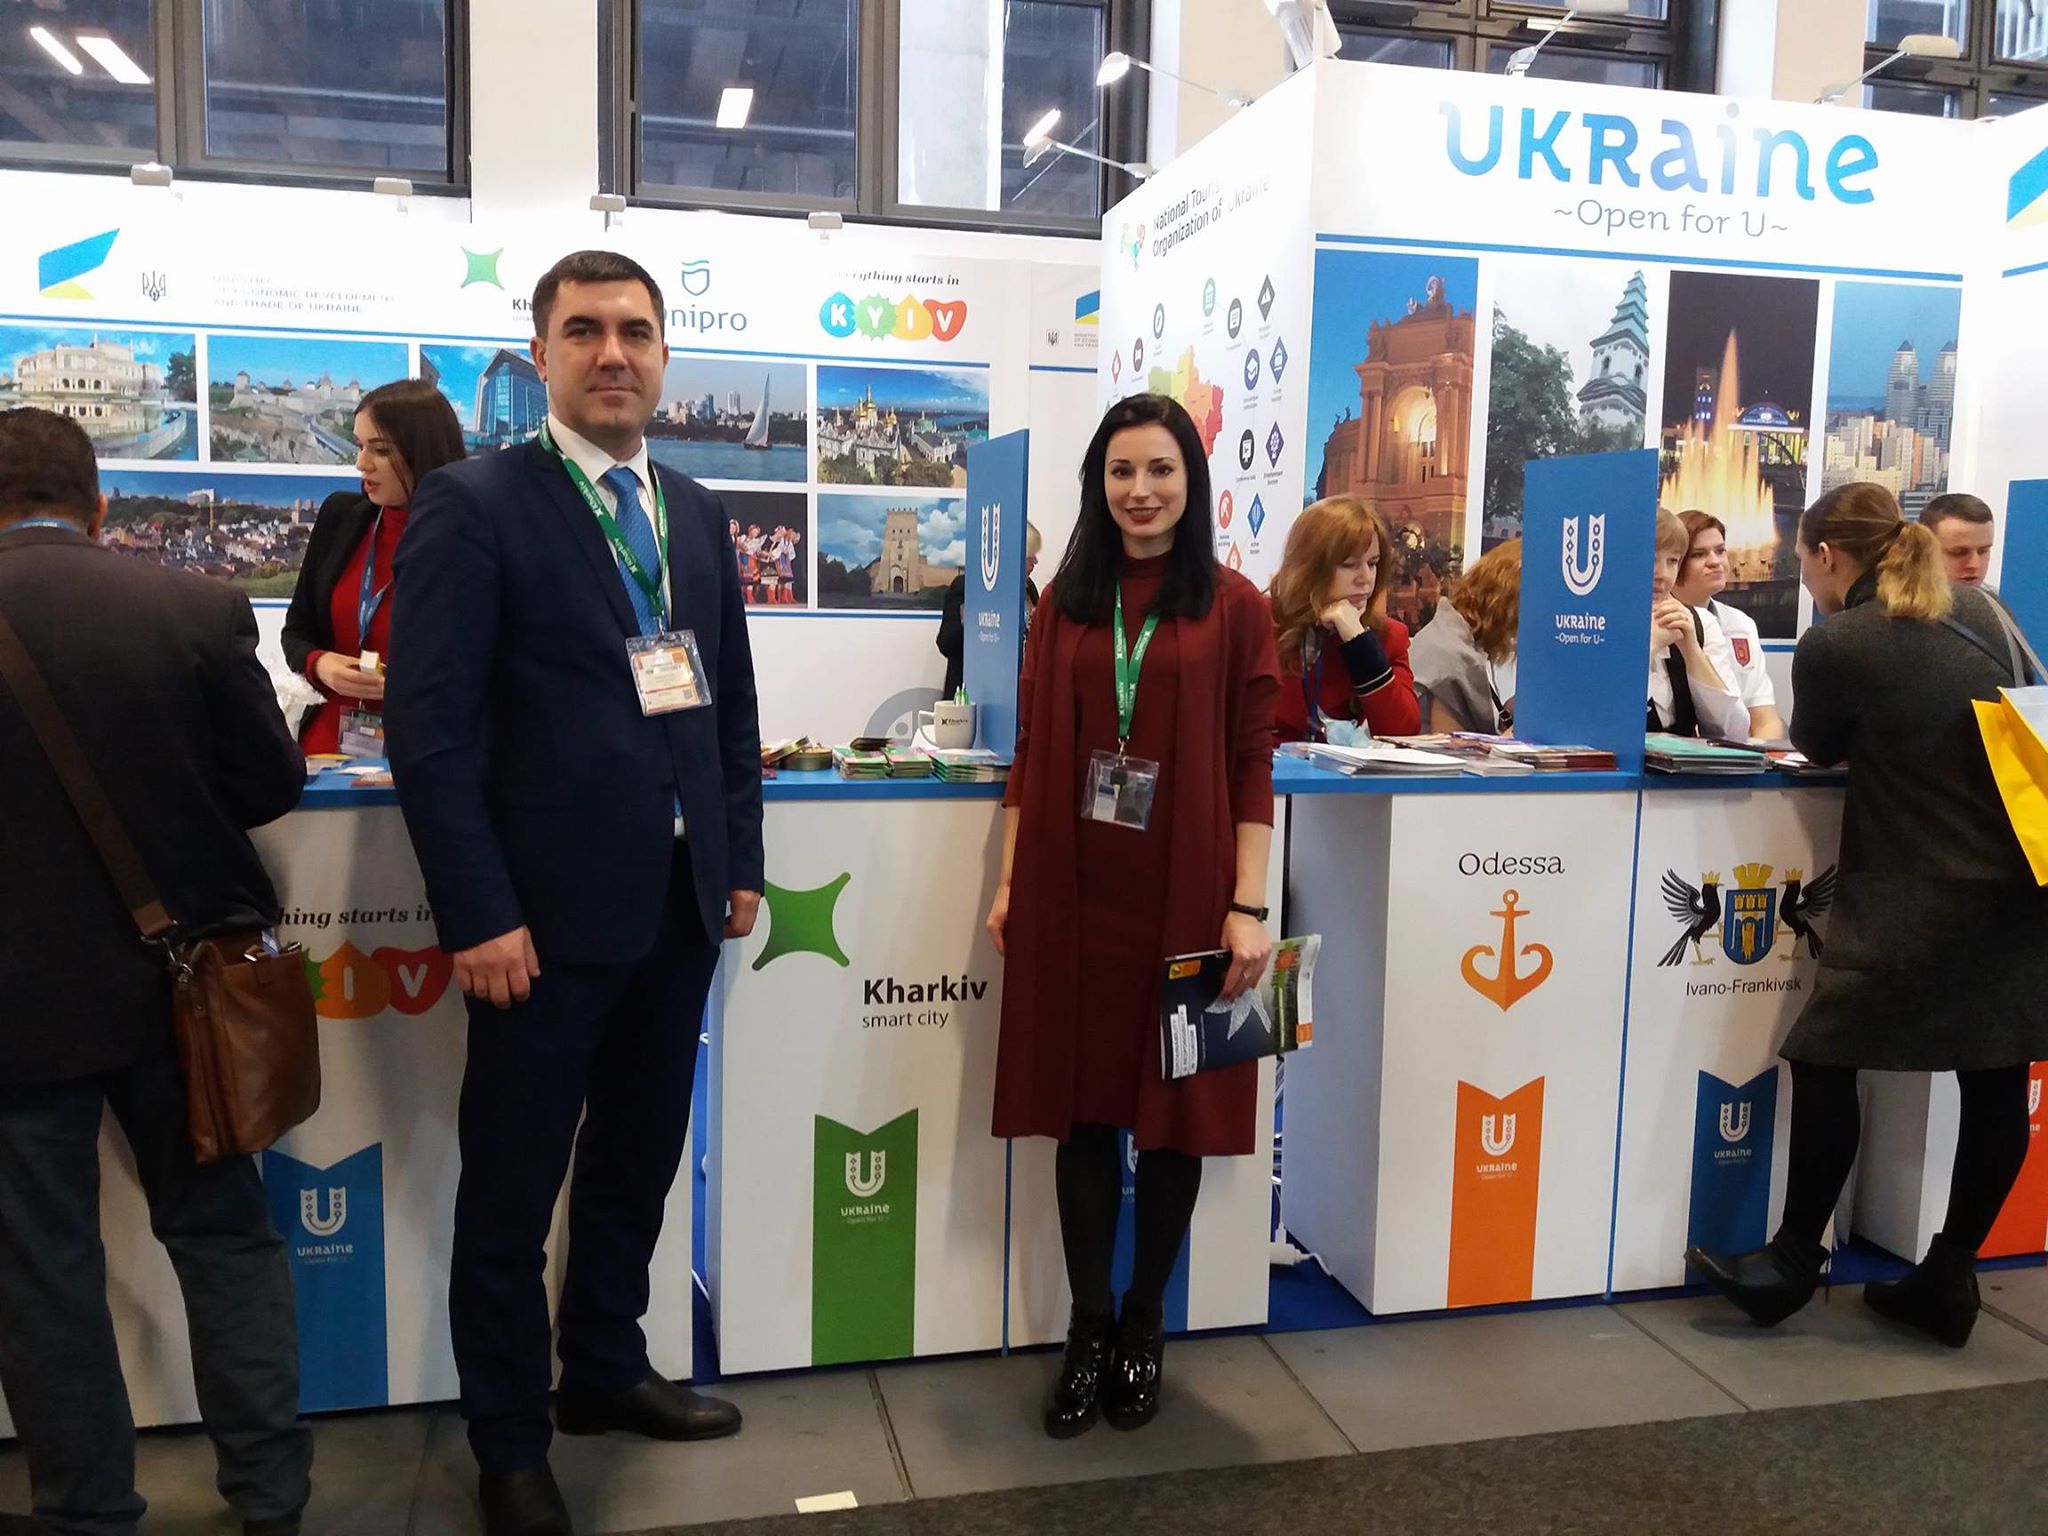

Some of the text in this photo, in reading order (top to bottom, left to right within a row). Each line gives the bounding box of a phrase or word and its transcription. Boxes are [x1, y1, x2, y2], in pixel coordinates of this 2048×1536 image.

[1153, 210, 1209, 257] Organization
[1229, 178, 1271, 212] kraine
[1154, 193, 1189, 230] National
[1681, 204, 1731, 235] for
[905, 272, 944, 286] starts
[947, 274, 960, 286] in
[308, 302, 363, 314] UKRAINE
[664, 304, 748, 334] nipro
[1458, 852, 1566, 876] Odessa
[337, 906, 409, 925] starts
[343, 963, 429, 1001] IV
[863, 974, 988, 1006] Kharkiv
[1685, 975, 1803, 997] Ivano-Frankivsk
[862, 1009, 949, 1029] smart city
